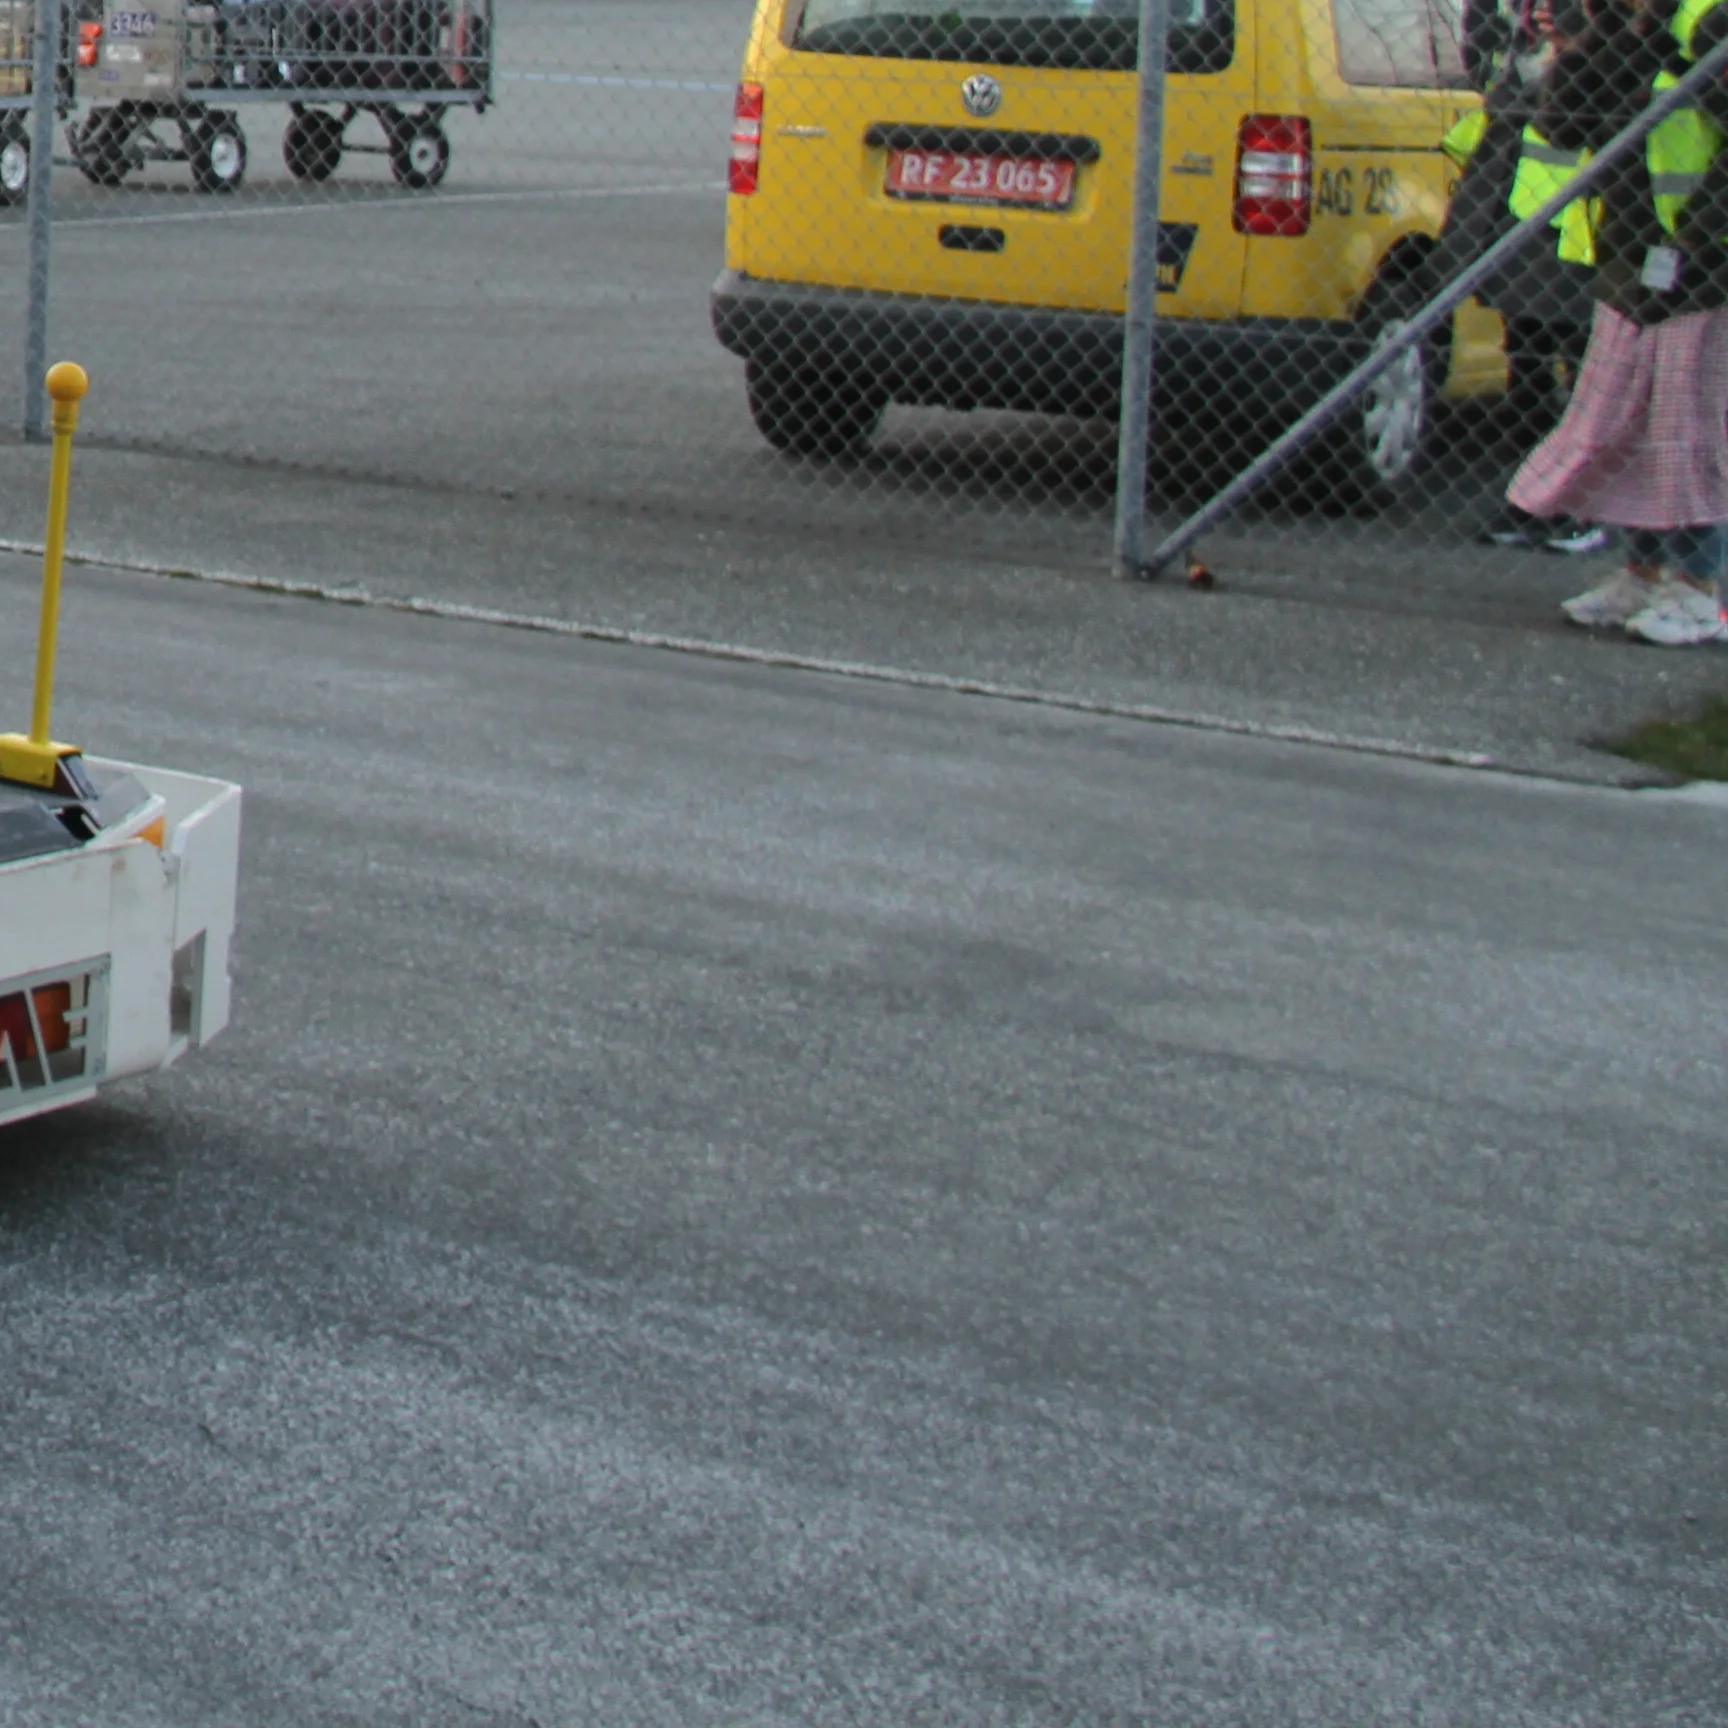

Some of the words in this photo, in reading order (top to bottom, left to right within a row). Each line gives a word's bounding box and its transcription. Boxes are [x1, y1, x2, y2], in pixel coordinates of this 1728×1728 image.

[901, 154, 945, 184] RF
[950, 156, 989, 189] 23
[997, 160, 1055, 195] 065
[1315, 167, 1353, 215] AG
